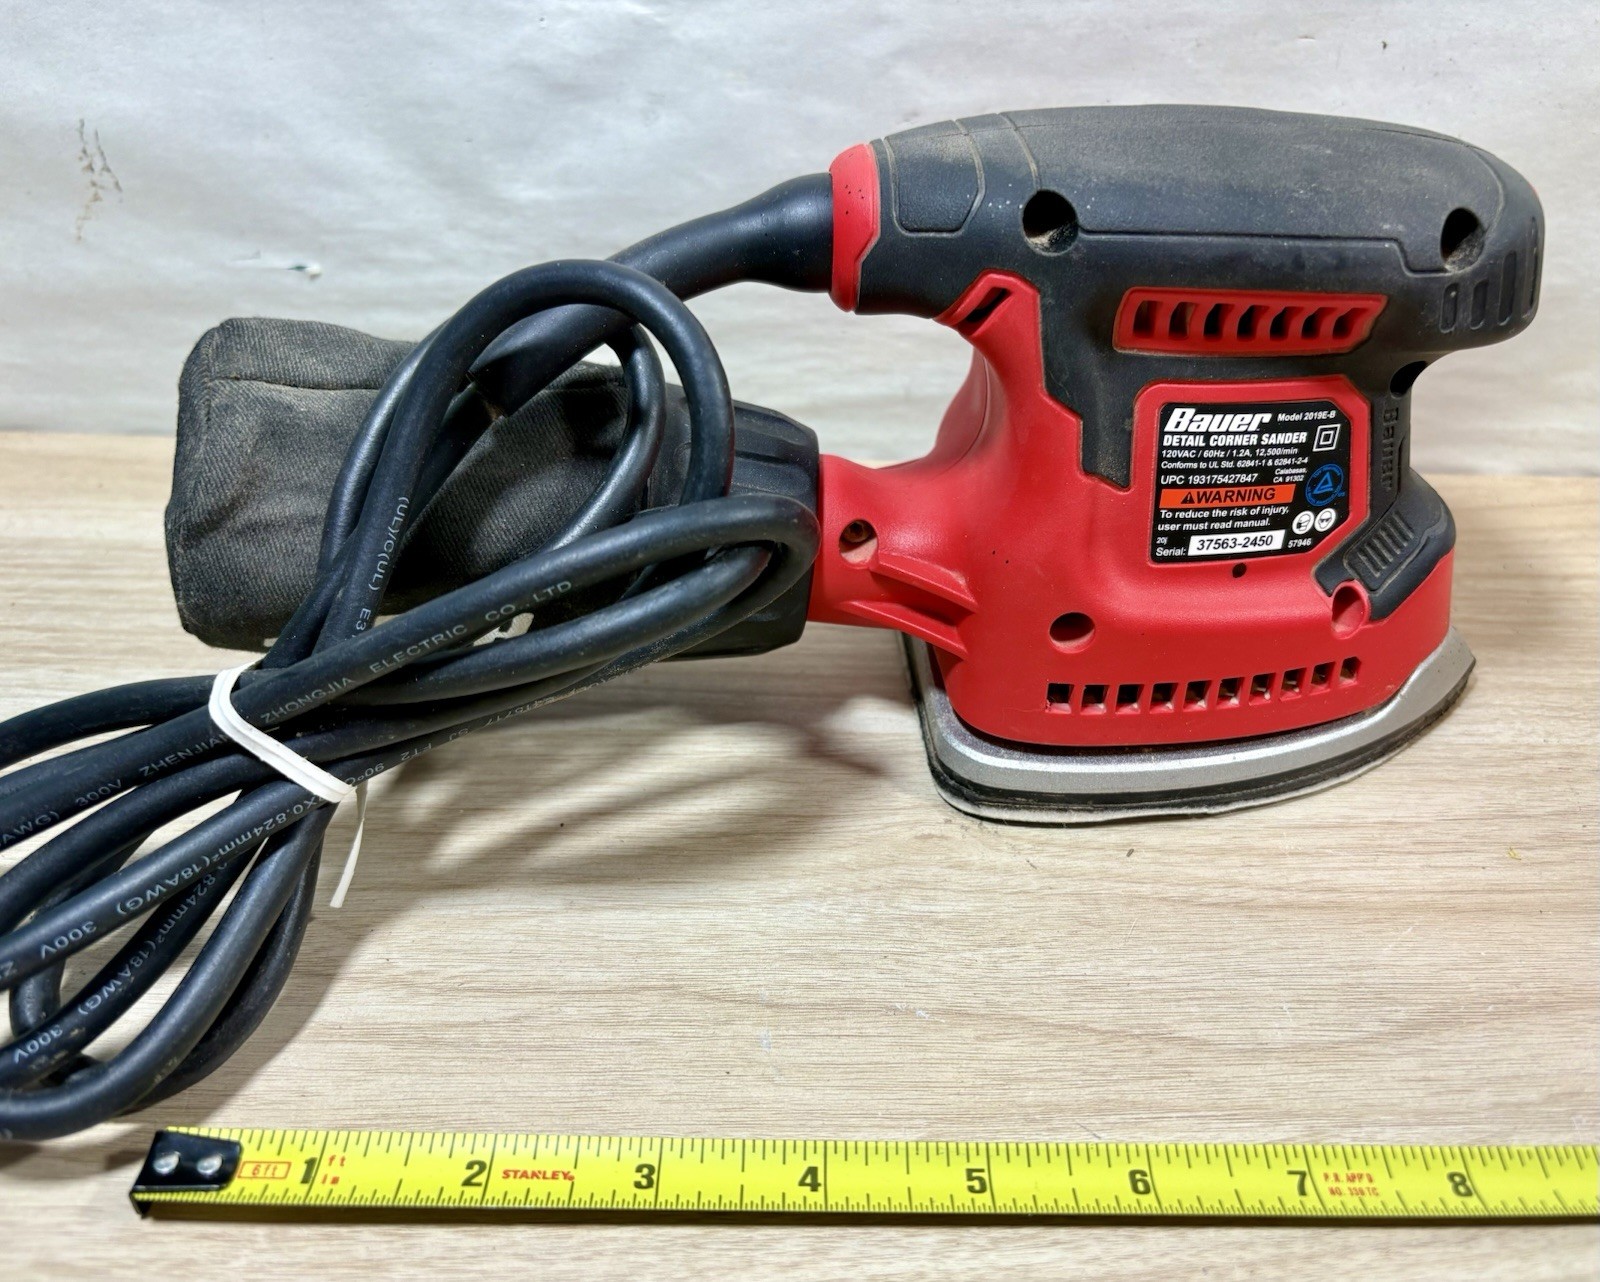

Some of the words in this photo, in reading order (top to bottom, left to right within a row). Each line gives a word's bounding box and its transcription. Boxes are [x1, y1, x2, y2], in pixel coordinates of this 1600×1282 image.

[1163, 408, 1272, 432] Bauer
[1277, 413, 1302, 421] Model
[1304, 410, 1336, 421] 2019E-B
[1161, 449, 1197, 458] 120VAC
[1203, 449, 1226, 458] 60Hz
[1232, 448, 1252, 458] 1.2A,
[1255, 446, 1298, 457] 12,500/min
[1163, 434, 1206, 447] DETAIL
[1209, 433, 1259, 447] CORNER
[1261, 432, 1308, 445] SANDER
[1161, 460, 1198, 469] Conforms
[1199, 460, 1207, 469] to
[1220, 460, 1235, 468] Std.
[1236, 458, 1266, 468] 62841-1
[1266, 458, 1273, 466] &
[1273, 456, 1309, 466] 62841-2-4
[1160, 475, 1185, 485] UPC
[1187, 473, 1258, 485] 193175427847
[1272, 476, 1283, 484] CA
[1285, 475, 1305, 483] 91302
[1196, 487, 1276, 504] WARNING
[1157, 523, 1181, 531] user
[1182, 521, 1209, 531] must
[1210, 520, 1233, 529] read
[1233, 517, 1271, 528] manual.
[1160, 509, 1173, 519] To
[1175, 509, 1210, 519] reduce
[1211, 508, 1228, 517] the
[1229, 507, 1248, 516] risk
[1250, 506, 1260, 516] of
[1261, 505, 1289, 516] injury,
[1155, 546, 1187, 557] Serial:
[1196, 535, 1274, 551] 37563-2450
[1287, 537, 1312, 548] 57946
[352, 608, 371, 638] E3
[260, 676, 354, 724] ZHONGJIA
[369, 624, 468, 673] ELECTRIC
[0, 811, 60, 847] AWG)
[75, 778, 123, 807] 300V
[40, 921, 97, 960] 300V
[13, 1024, 63, 1064] 300V
[300, 1157, 318, 1185] 1
[461, 1159, 488, 1187] 2
[633, 1163, 656, 1190] 3
[798, 1166, 822, 1192] 4
[966, 1168, 988, 1194] 5
[1128, 1169, 1152, 1195] 6
[1286, 1170, 1308, 1197] 7
[1446, 1171, 1474, 1198] 8
